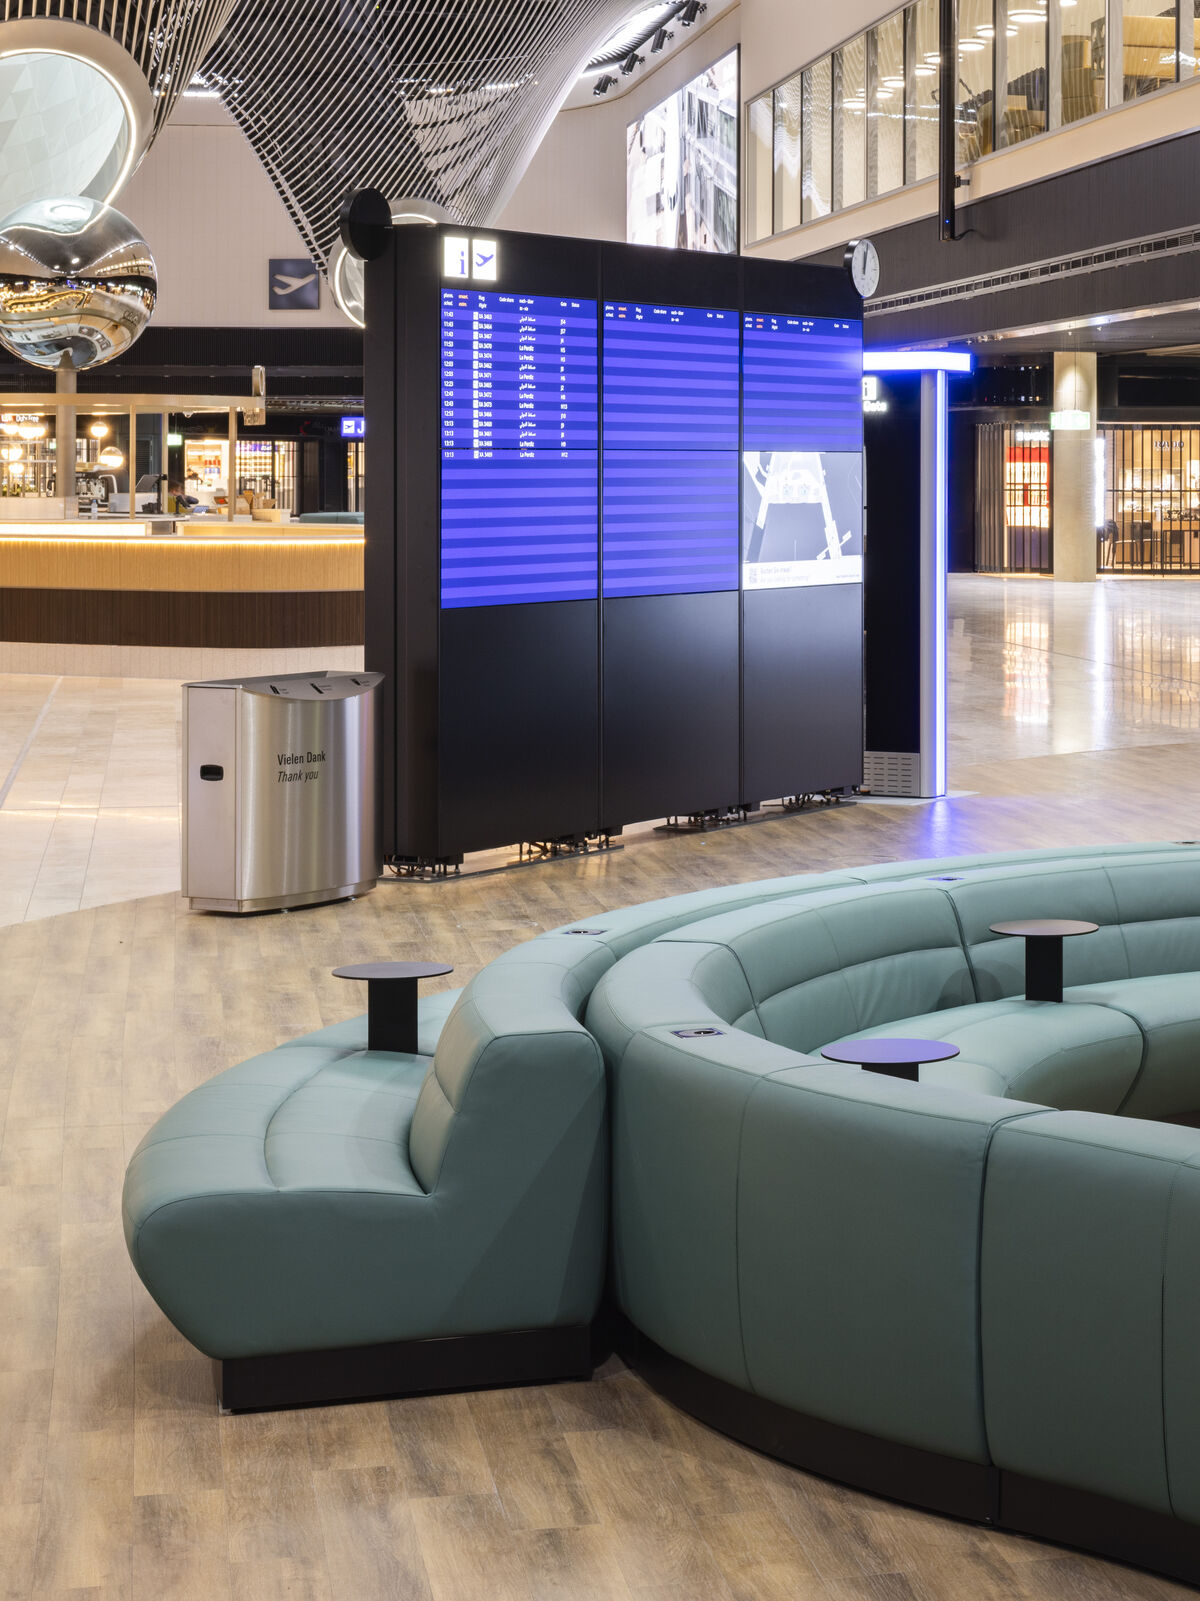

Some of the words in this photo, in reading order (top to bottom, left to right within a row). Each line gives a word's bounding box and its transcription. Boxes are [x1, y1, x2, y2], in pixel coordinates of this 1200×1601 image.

[1016, 431, 1050, 441] swatc
[277, 752, 304, 766] Vielen
[306, 750, 326, 763] Dank
[277, 770, 302, 783] Thank
[304, 770, 319, 782] you
